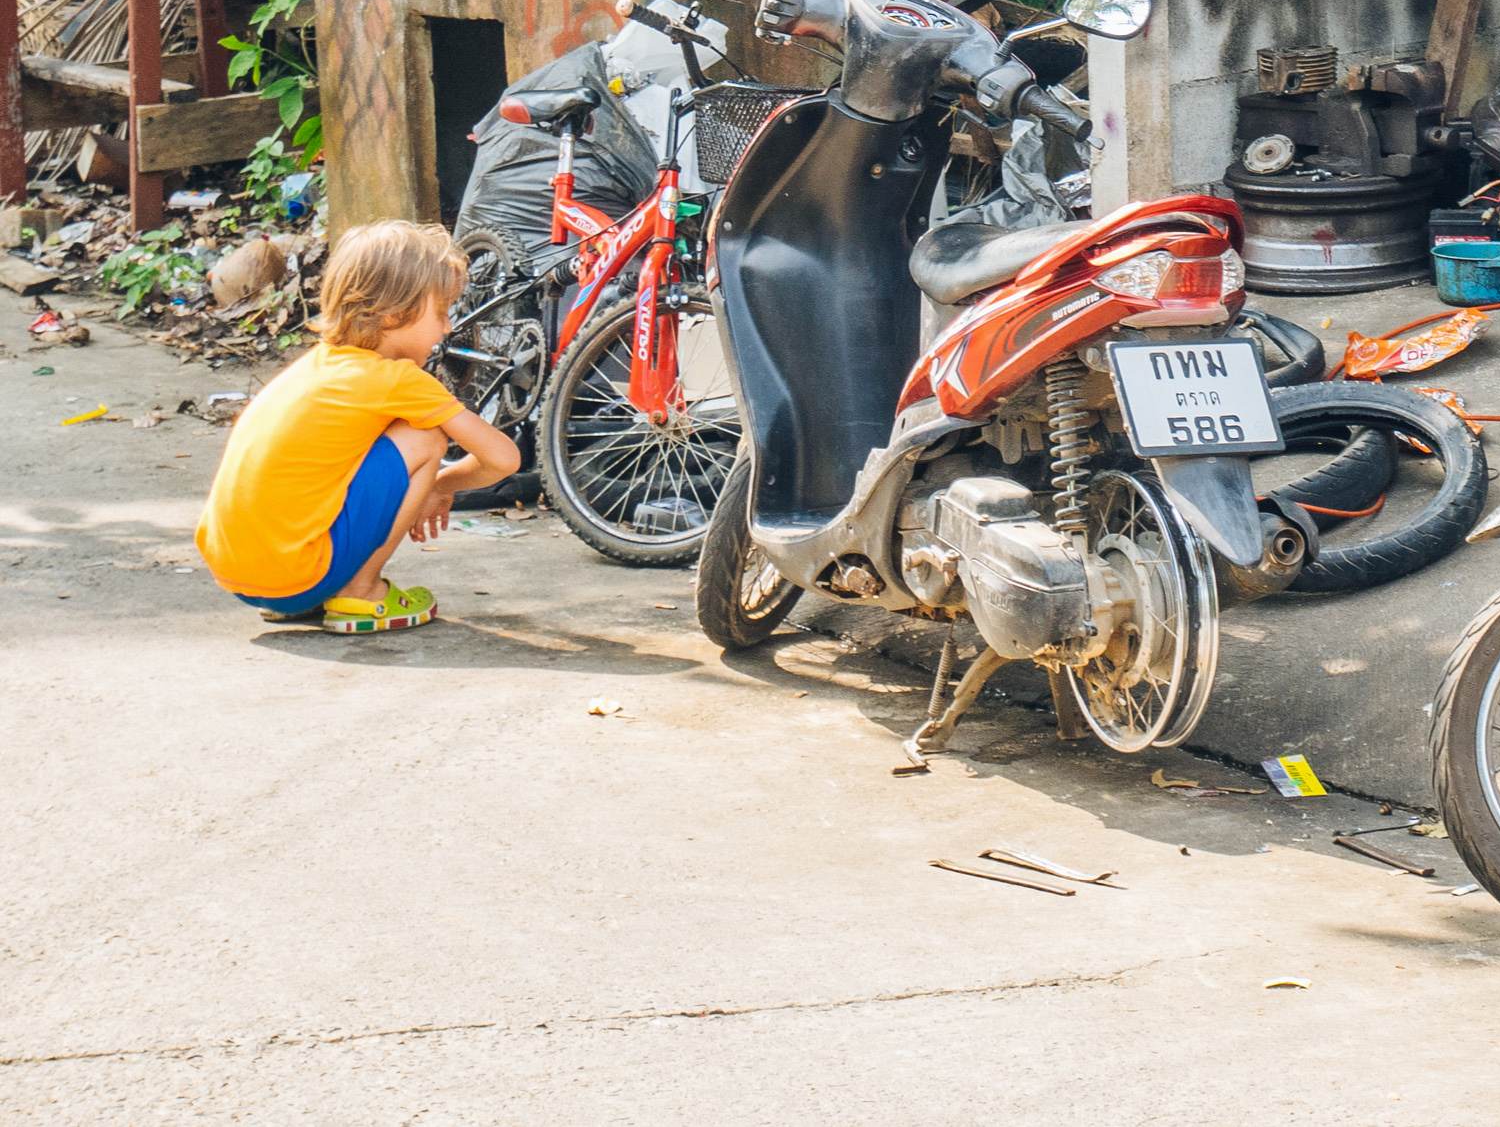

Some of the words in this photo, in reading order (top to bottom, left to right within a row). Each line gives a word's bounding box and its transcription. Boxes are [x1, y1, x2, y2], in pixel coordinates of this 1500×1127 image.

[1051, 291, 1100, 321] AUTOMATIC
[1149, 350, 1228, 380] กทม
[1175, 391, 1221, 407] ตราด
[1167, 415, 1246, 445] 586
